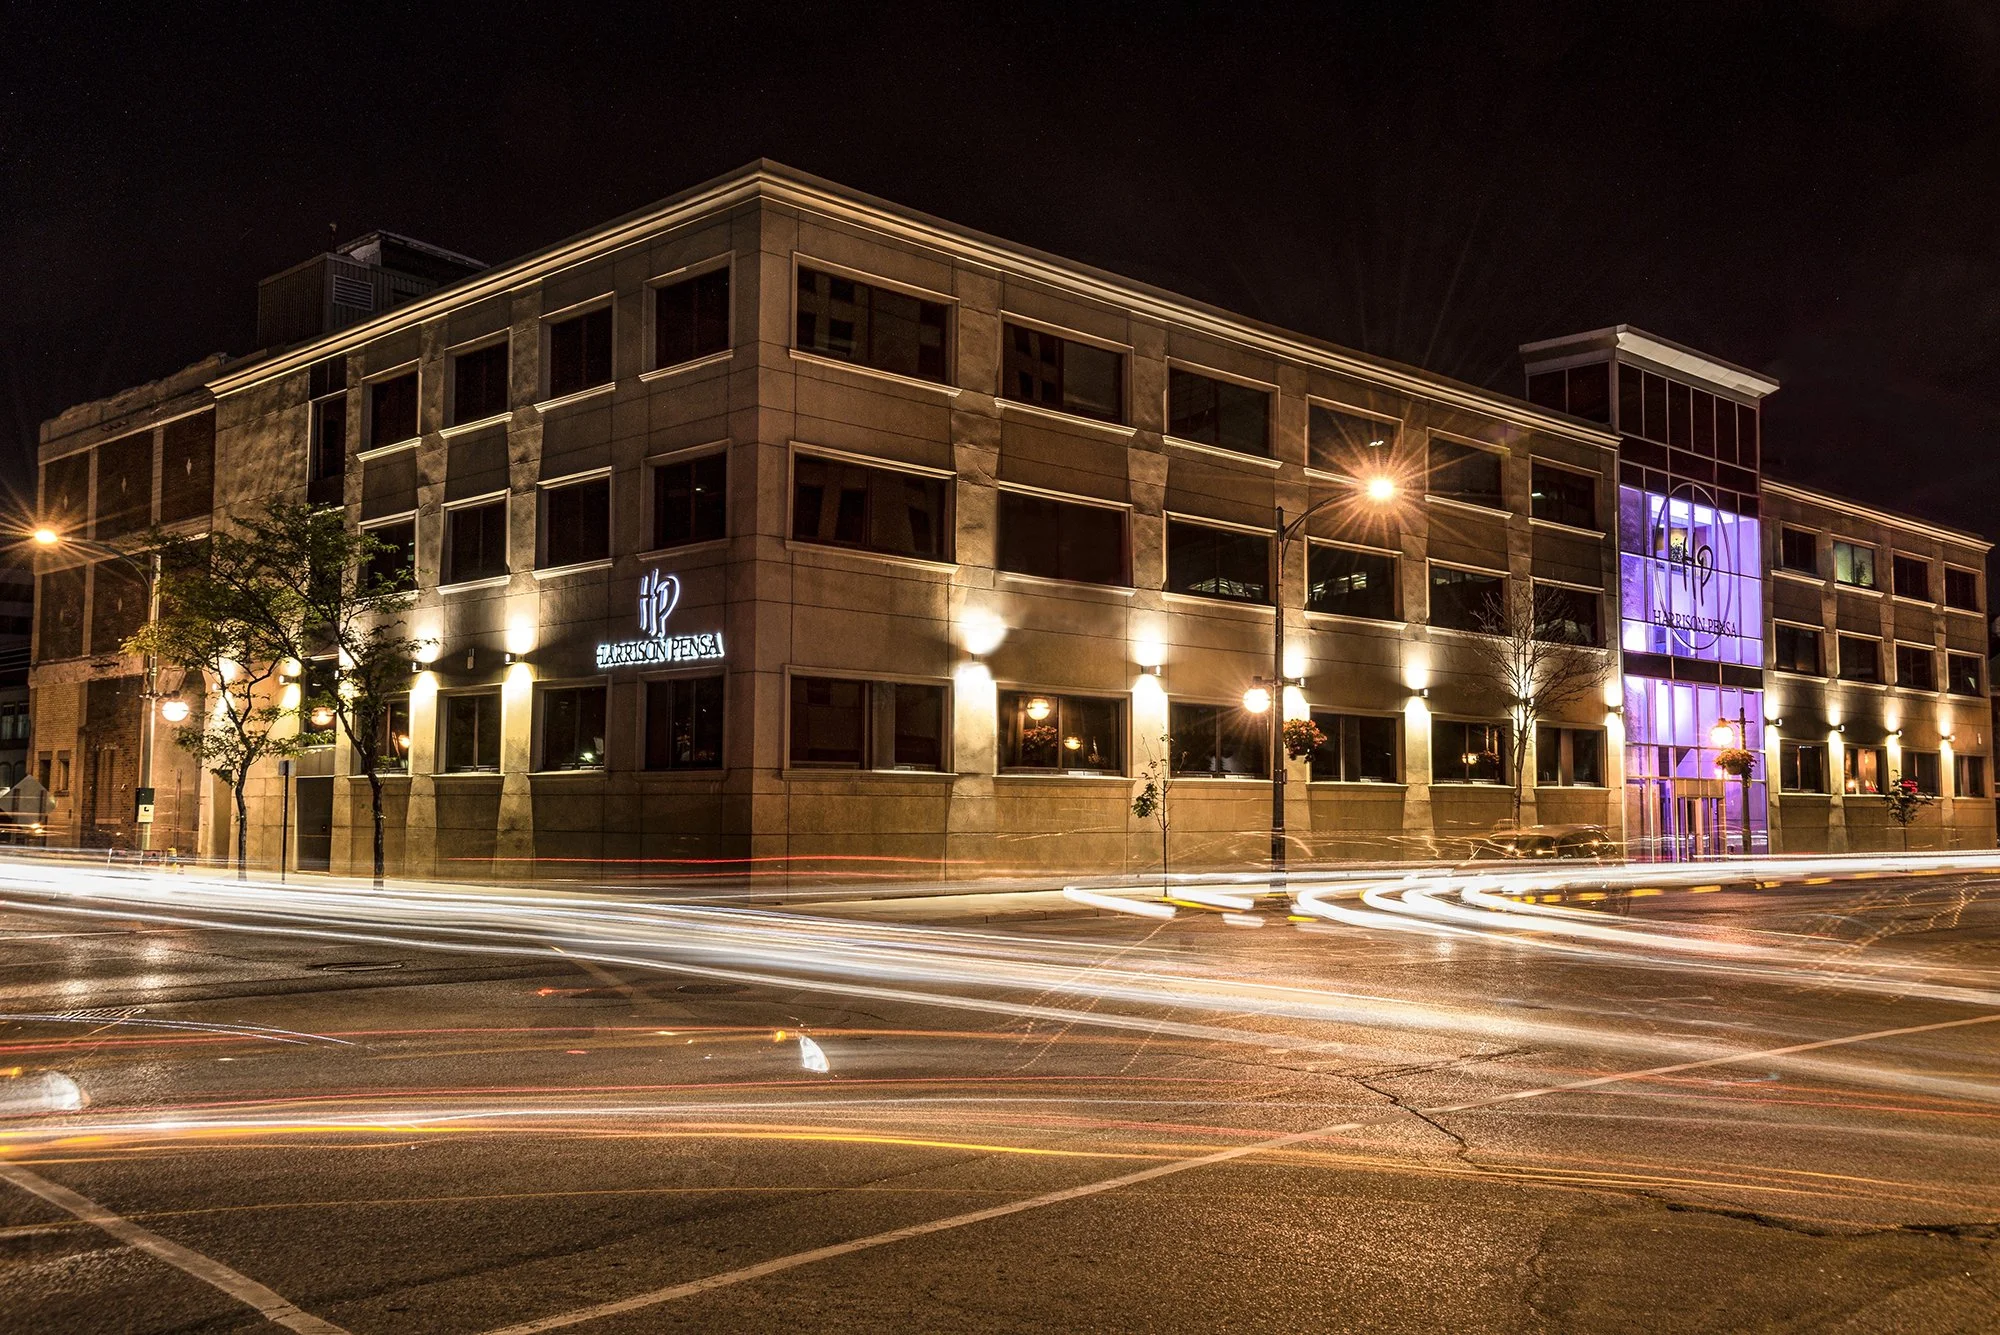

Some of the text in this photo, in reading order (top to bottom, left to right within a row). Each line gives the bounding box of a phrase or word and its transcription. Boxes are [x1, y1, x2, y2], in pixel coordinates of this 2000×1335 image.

[1653, 609, 1738, 638] HARRISON PENSA
[596, 632, 725, 668] HARRISON PENSA
